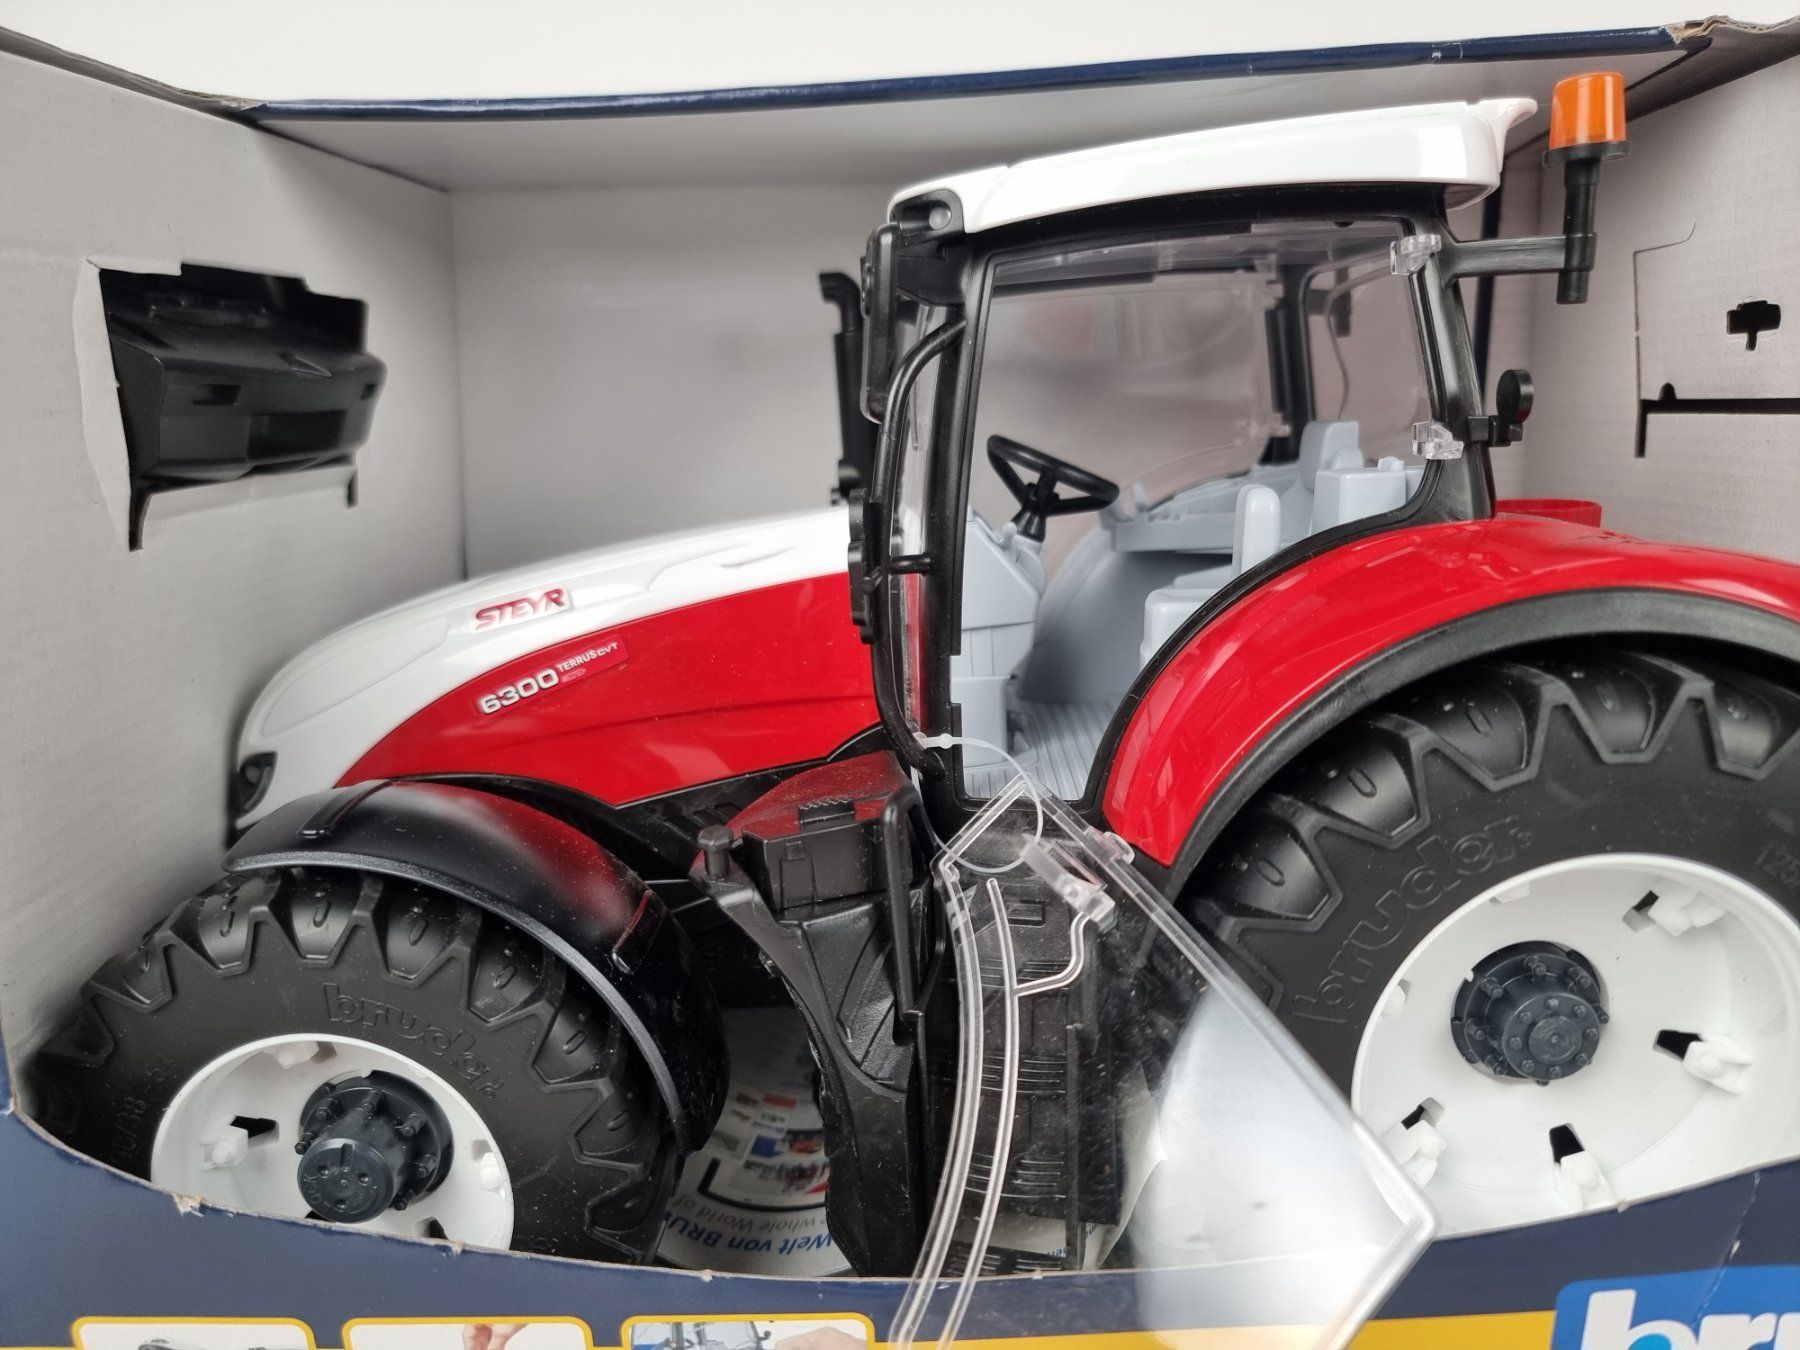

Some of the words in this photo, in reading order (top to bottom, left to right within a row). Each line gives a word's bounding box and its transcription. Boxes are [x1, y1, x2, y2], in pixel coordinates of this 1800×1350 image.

[475, 588, 566, 631] STEYR
[479, 667, 560, 714] 6300
[1293, 816, 1518, 1023] bruder
[323, 982, 504, 1093] bruder
[671, 1193, 696, 1209] of
[694, 1206, 753, 1232] World
[662, 1212, 723, 1247] BRU
[727, 1236, 772, 1253] von
[757, 1218, 818, 1234] whole
[1580, 1288, 1800, 1350] br
